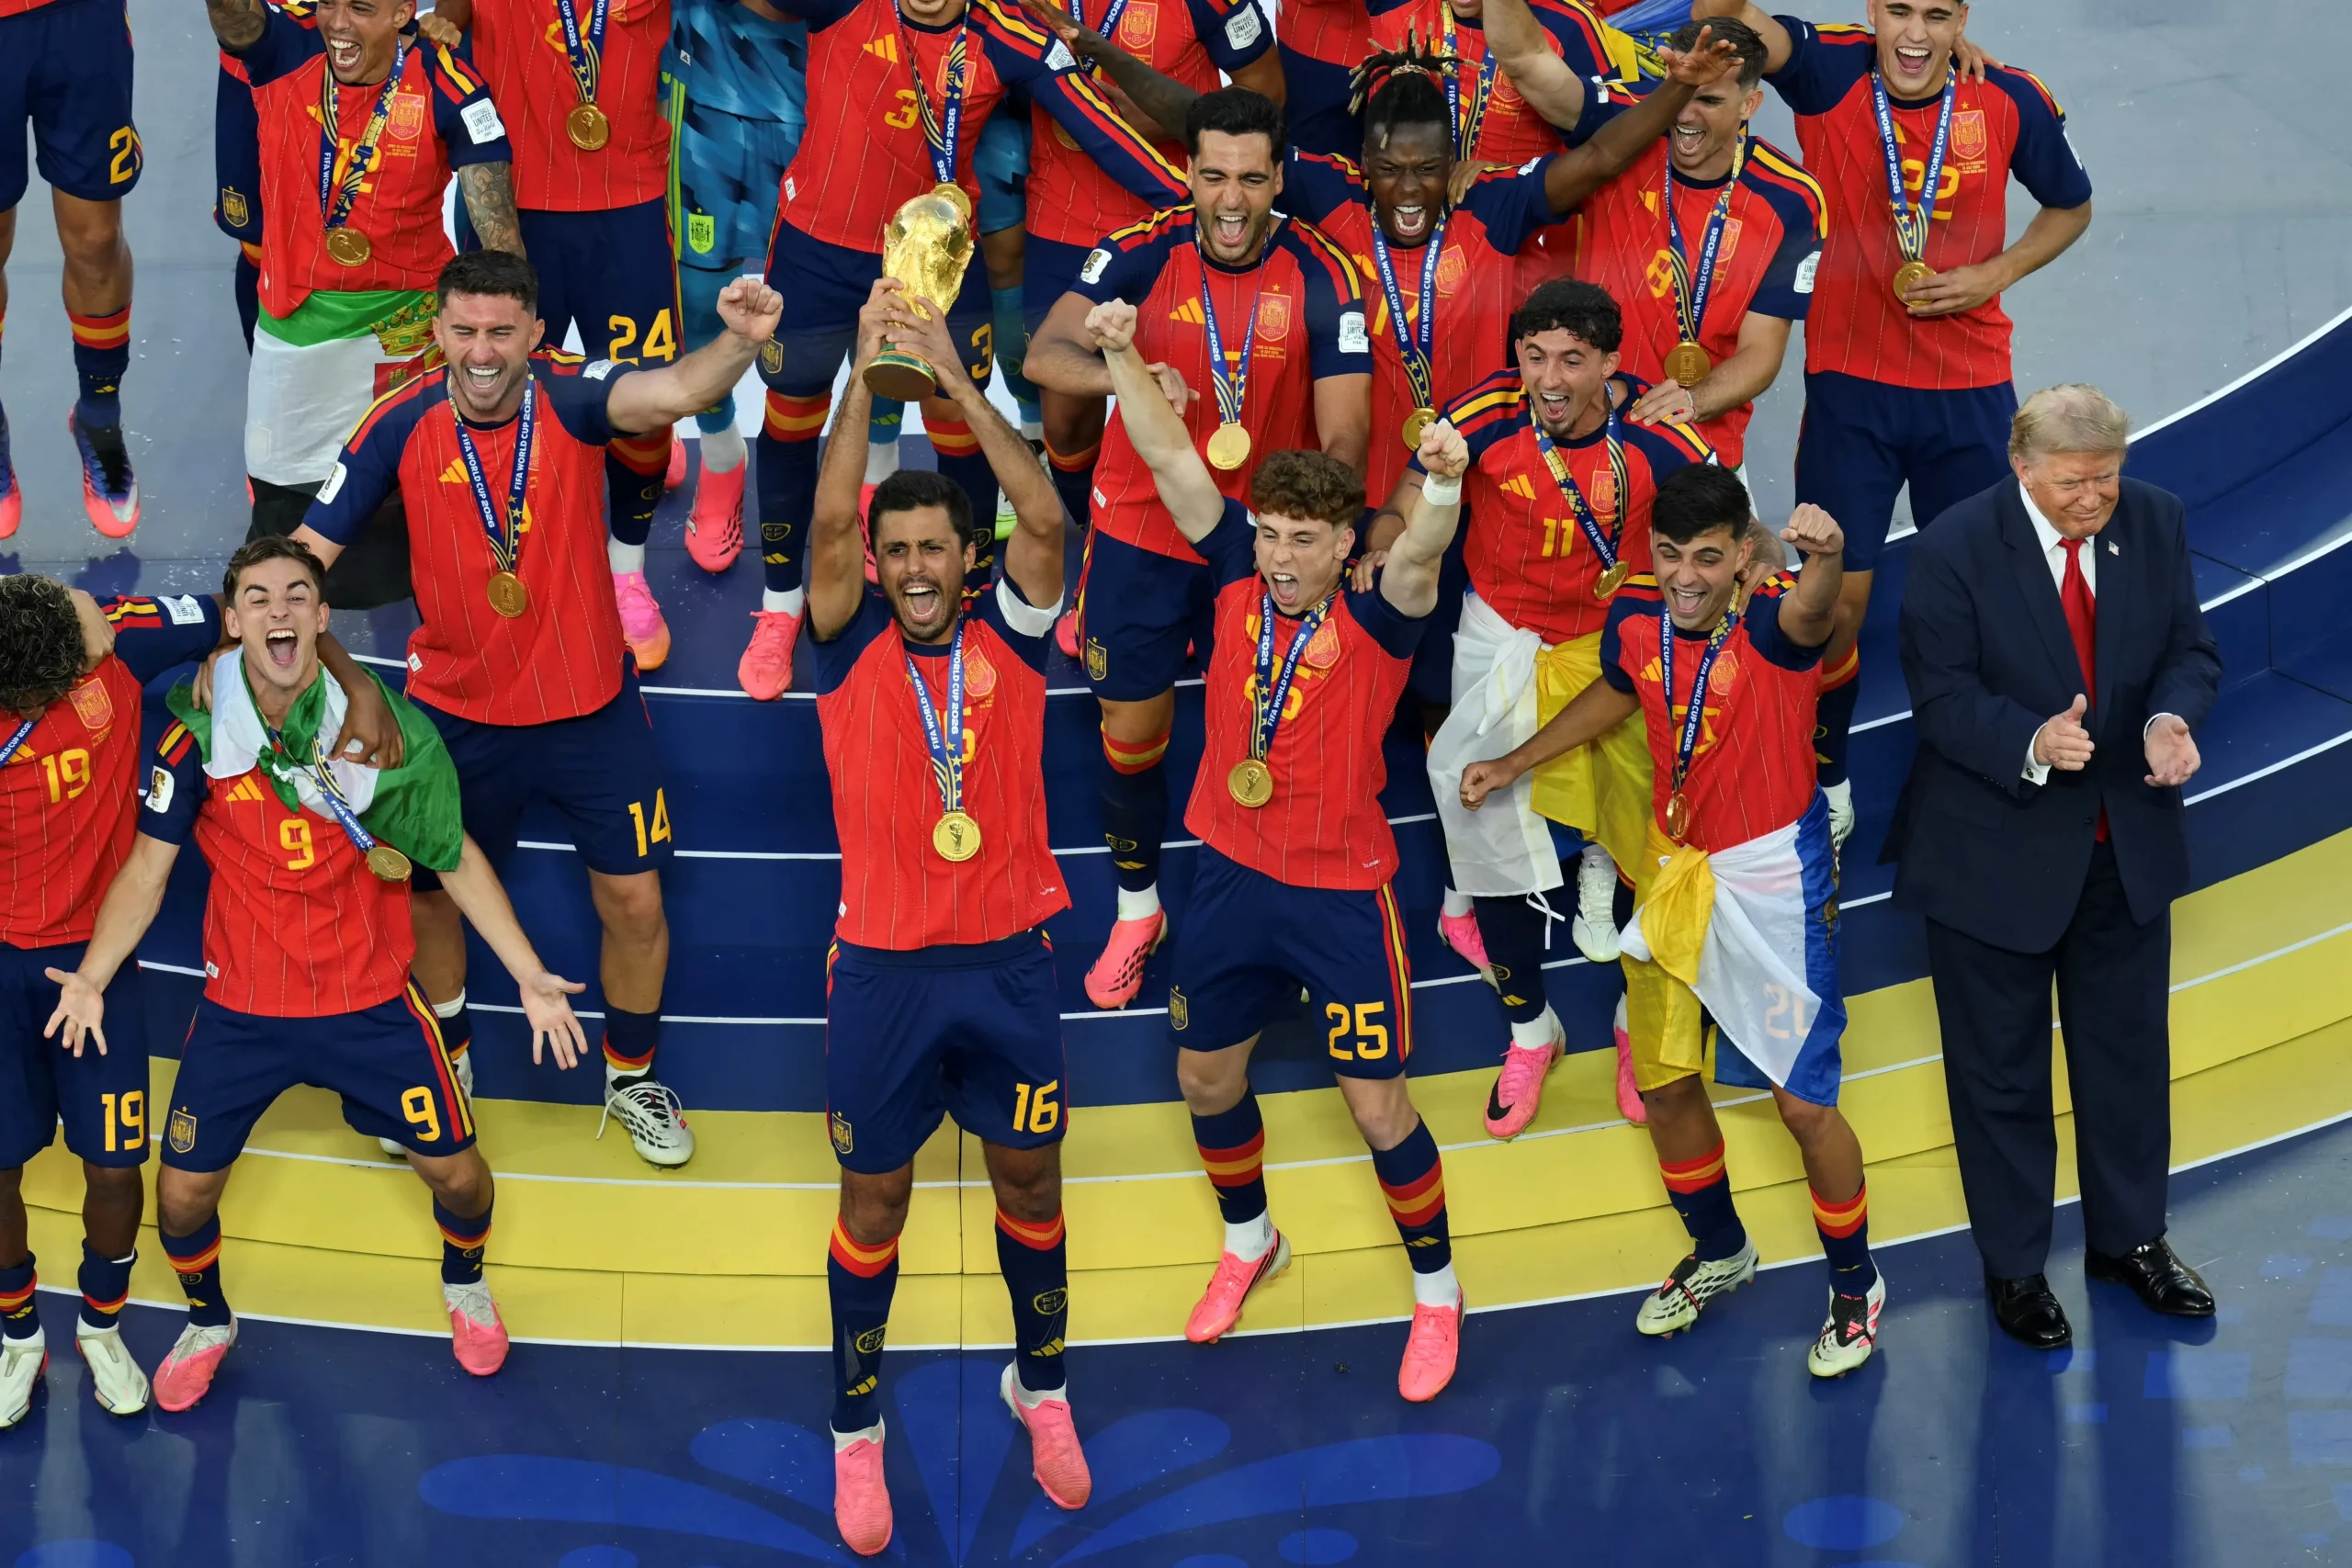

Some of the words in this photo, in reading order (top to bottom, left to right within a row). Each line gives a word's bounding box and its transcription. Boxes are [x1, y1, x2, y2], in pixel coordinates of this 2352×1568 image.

[561, 0, 571, 17] CUP
[1072, 0, 1081, 22] 202
[565, 18, 578, 47] 2026
[594, 17, 603, 34] FIFA
[884, 89, 920, 129] 3
[1876, 92, 1885, 111] FIFA
[1940, 95, 1951, 127] 2026
[946, 107, 956, 138] 2026
[1880, 111, 1892, 142] WORLD
[1936, 127, 1945, 146] CUP
[109, 125, 141, 185] 2
[323, 152, 331, 170] FIFA
[1887, 143, 1896, 162] CUP
[1929, 147, 1942, 179] WORLD
[937, 160, 948, 182] 026
[1890, 163, 1901, 194] 2026
[1924, 178, 1934, 198] FIFA
[1425, 239, 1439, 271] 2026
[1706, 227, 1719, 257] 2026
[1702, 258, 1711, 277] CUP
[1377, 241, 1386, 260] FIFA
[1382, 261, 1395, 293] WORLD
[1390, 293, 1400, 311] CUP
[1395, 311, 1408, 343] 2026
[1422, 290, 1430, 323] WORLD
[1696, 277, 1707, 305] WORLD
[609, 308, 676, 367] 24
[1210, 332, 1221, 362] 2026
[1421, 323, 1430, 342] FIFA
[971, 322, 993, 380] 3
[523, 389, 531, 421] 2026
[521, 422, 529, 440] CUP
[517, 440, 528, 471] WORLD
[462, 433, 472, 452] FIFA
[467, 453, 482, 486] WORLD
[476, 482, 486, 499] CUP
[481, 499, 495, 528] 2026
[514, 471, 523, 490] FIFA
[1541, 518, 1574, 557] 11
[1585, 521, 1597, 537] FIFA
[1594, 535, 1610, 559] WORLD
[1607, 558, 1616, 568] CU
[952, 648, 962, 682] WORLD
[1261, 635, 1270, 666] 2026
[1267, 709, 1278, 727] FIFA
[1273, 679, 1287, 709] WORLD
[1283, 661, 1292, 679] CUP
[1289, 632, 1306, 663] 2026
[1700, 657, 1710, 679] FIFA
[915, 679, 925, 697] CUP
[1694, 678, 1705, 708] WORLD
[920, 697, 936, 729] WORLD
[1689, 706, 1699, 723] CUP
[8, 736, 20, 748] CUP
[17, 721, 34, 738] 202
[930, 729, 940, 750] FIFA
[1684, 722, 1696, 752] 2026
[41, 748, 90, 804] 19
[331, 800, 345, 817] FIFA
[345, 815, 368, 842] WORLD
[628, 787, 672, 857] 14
[280, 819, 314, 870] 9
[1326, 1001, 1388, 1060] 25
[101, 1090, 144, 1151] 19
[401, 1086, 440, 1142] 9
[1012, 1079, 1059, 1134] 16
